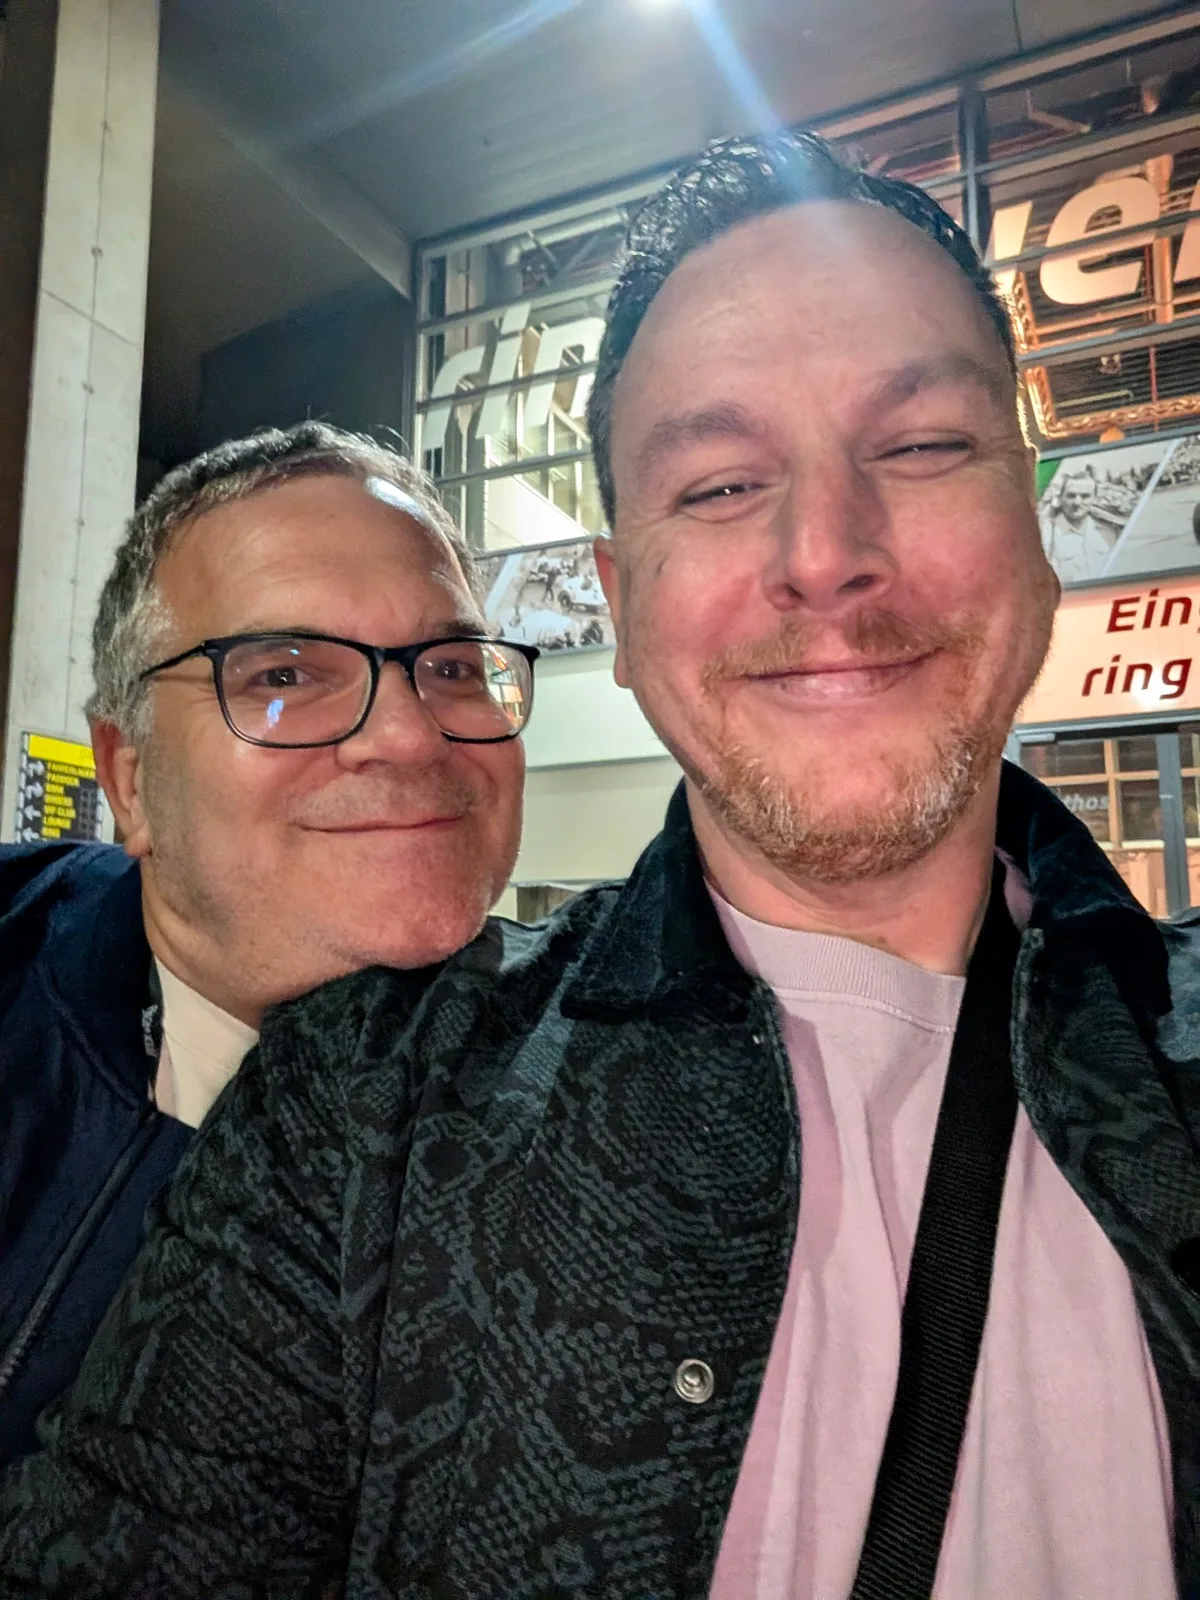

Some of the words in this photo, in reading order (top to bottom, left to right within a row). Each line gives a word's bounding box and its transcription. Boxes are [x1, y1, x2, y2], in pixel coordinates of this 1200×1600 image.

[423, 303, 606, 450] rin
[1106, 588, 1200, 634] Ein
[1081, 654, 1192, 700] ring
